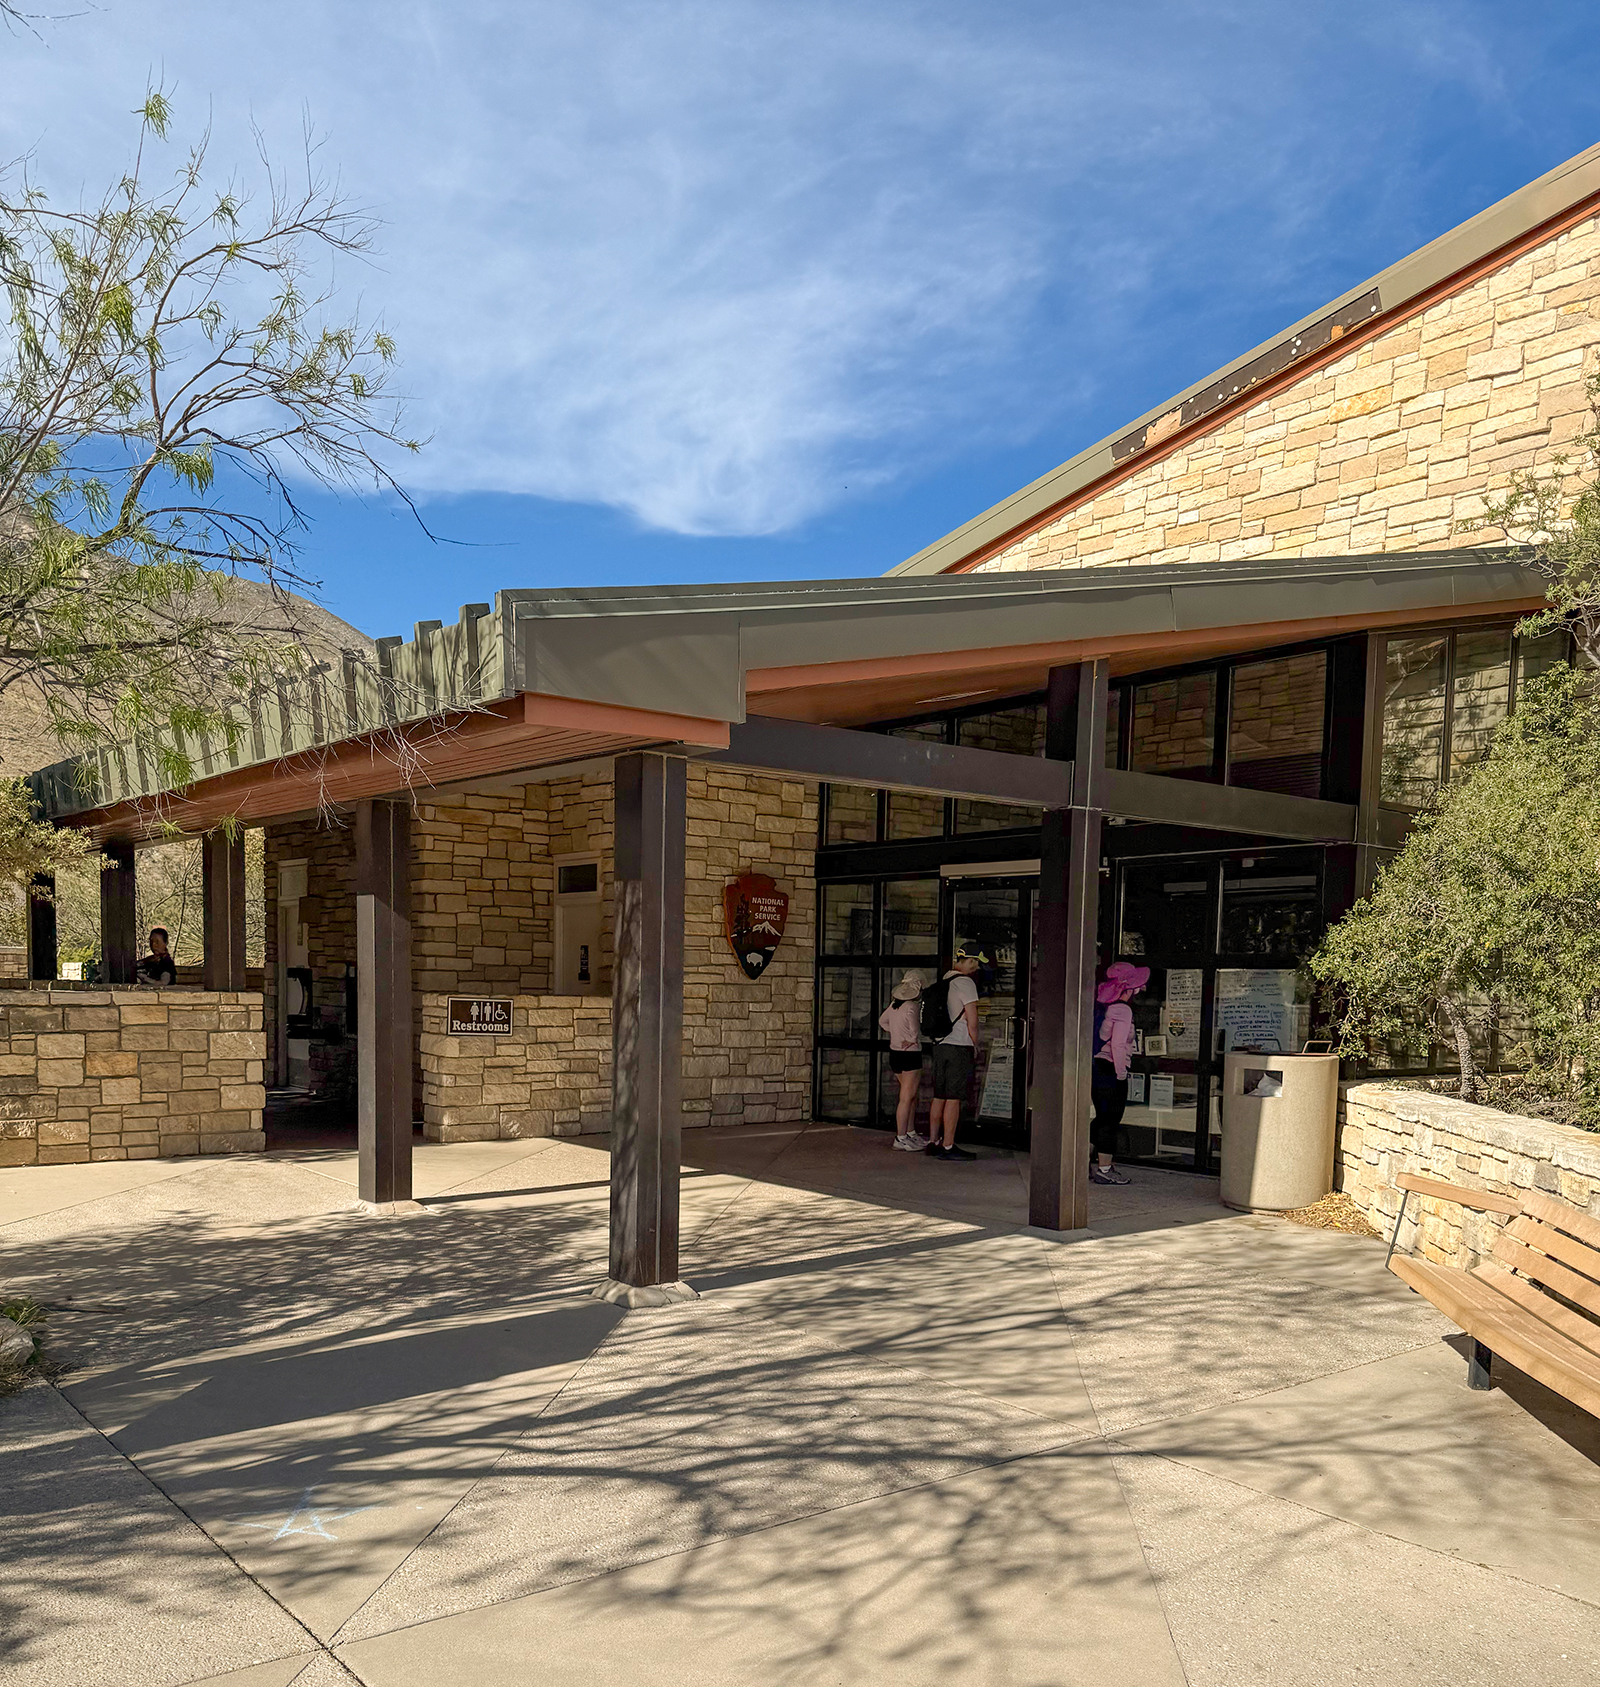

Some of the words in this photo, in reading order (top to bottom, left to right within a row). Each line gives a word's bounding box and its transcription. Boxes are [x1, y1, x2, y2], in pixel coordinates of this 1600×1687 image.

[752, 897, 784, 906] NATIONAL
[755, 912, 781, 921] SERVICE
[452, 1020, 509, 1031] Restrooms
